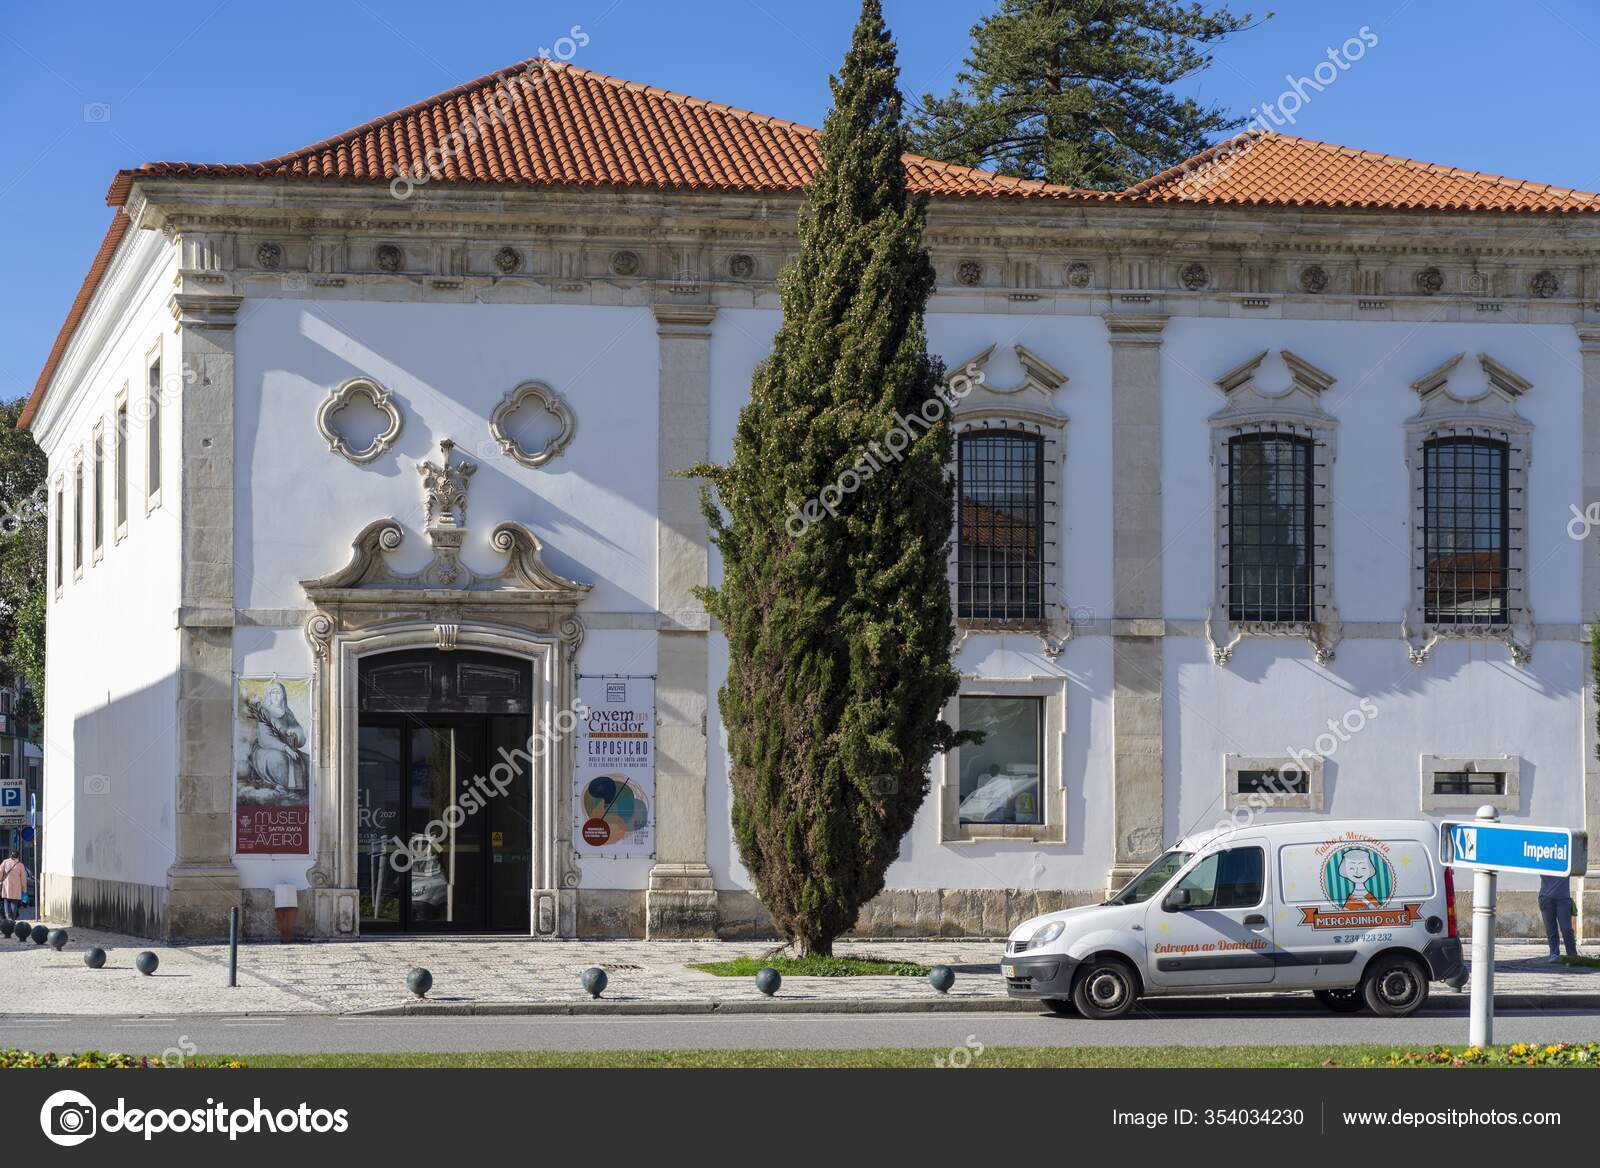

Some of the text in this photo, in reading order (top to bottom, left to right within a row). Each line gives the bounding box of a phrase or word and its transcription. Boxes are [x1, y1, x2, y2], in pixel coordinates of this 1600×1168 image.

[584, 706, 634, 721] Jovem
[588, 720, 644, 732] Criador
[255, 811, 307, 825] MUSEU
[255, 825, 267, 833] DE
[255, 833, 303, 846] AVEIRO
[1523, 841, 1567, 861] Imperial
[1316, 915, 1383, 927] MERCADINHO
[1154, 943, 1200, 955] Entregas
[1202, 943, 1216, 951] ao
